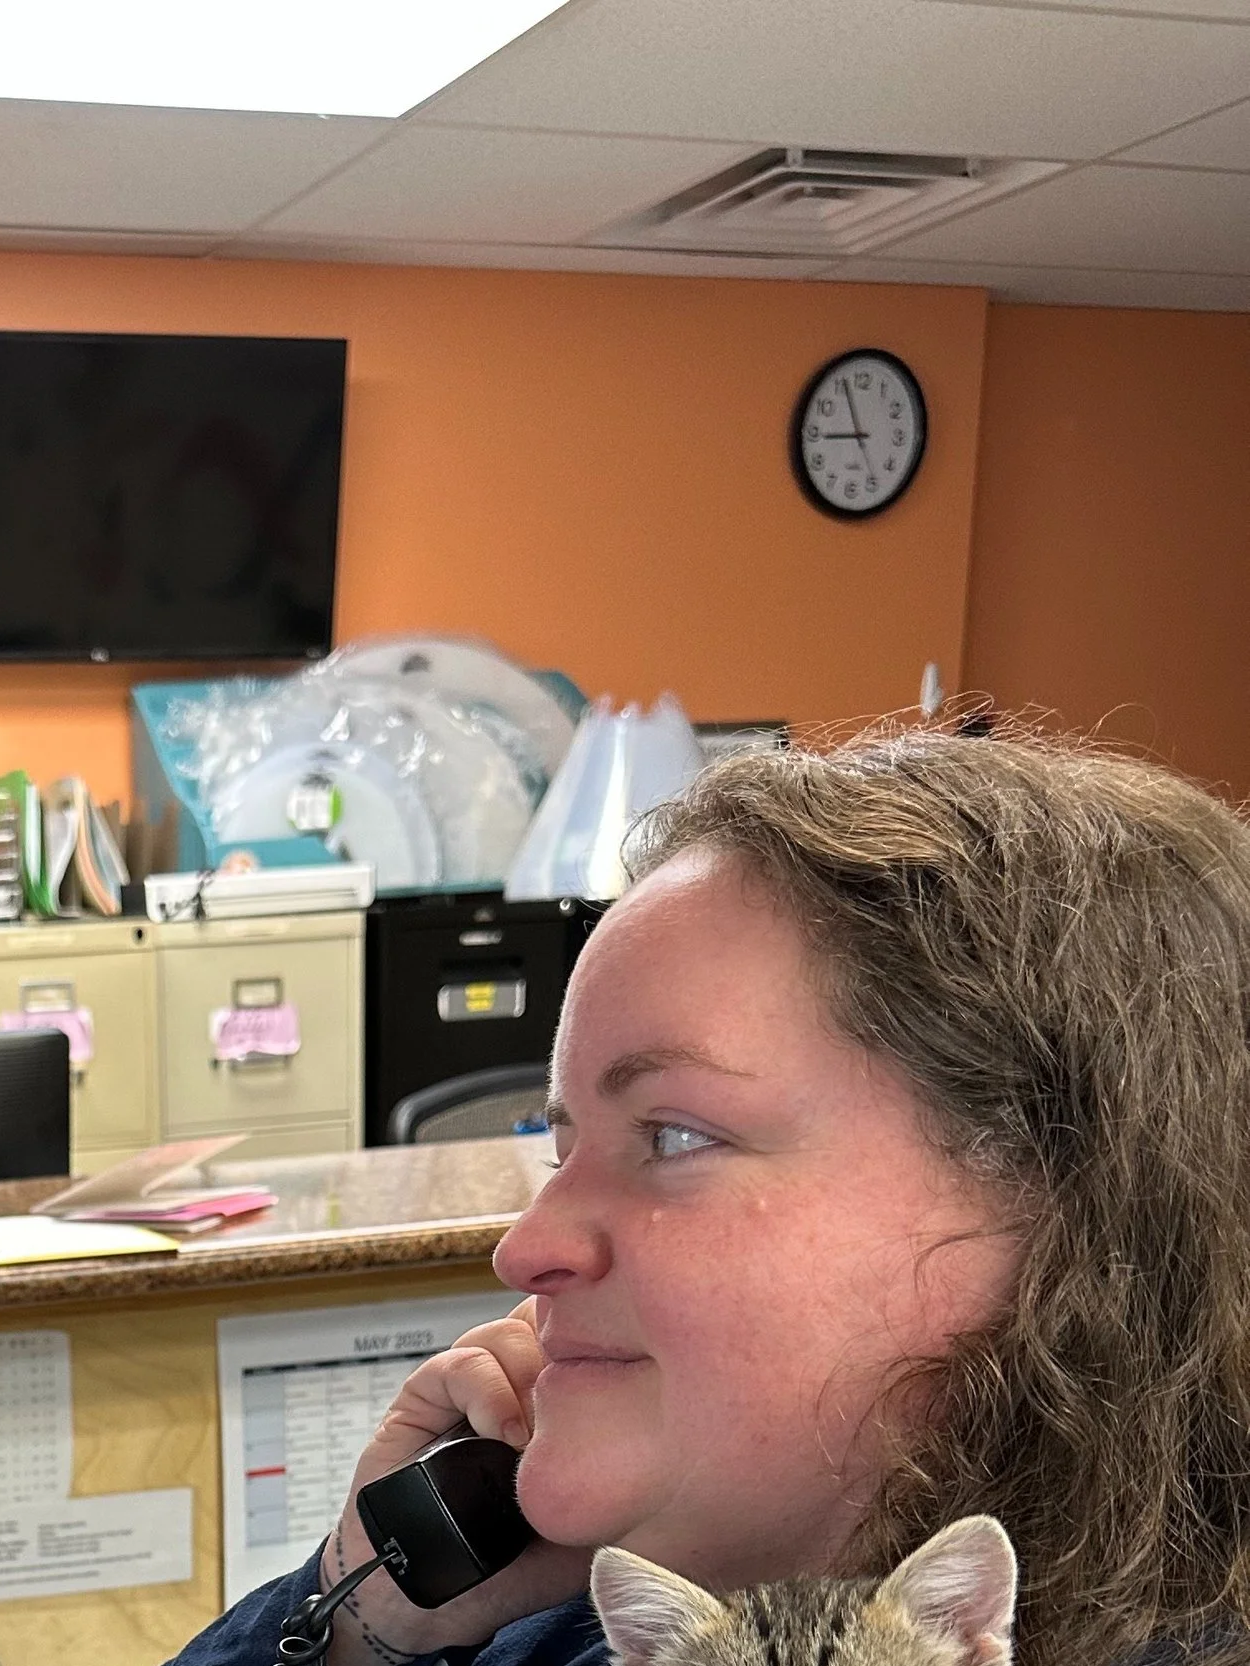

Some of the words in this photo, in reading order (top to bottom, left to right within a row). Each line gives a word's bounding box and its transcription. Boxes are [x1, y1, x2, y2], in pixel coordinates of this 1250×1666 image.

[854, 372, 870, 390] 12
[880, 380, 886, 398] 1
[817, 400, 834, 417] 10
[889, 402, 901, 419] 2
[808, 425, 820, 442] 9
[893, 429, 904, 447] 3
[812, 453, 825, 471] 8
[884, 455, 896, 472] 4
[826, 474, 838, 490] 7
[844, 482, 858, 499] 6
[353, 1334, 391, 1353] MAY
